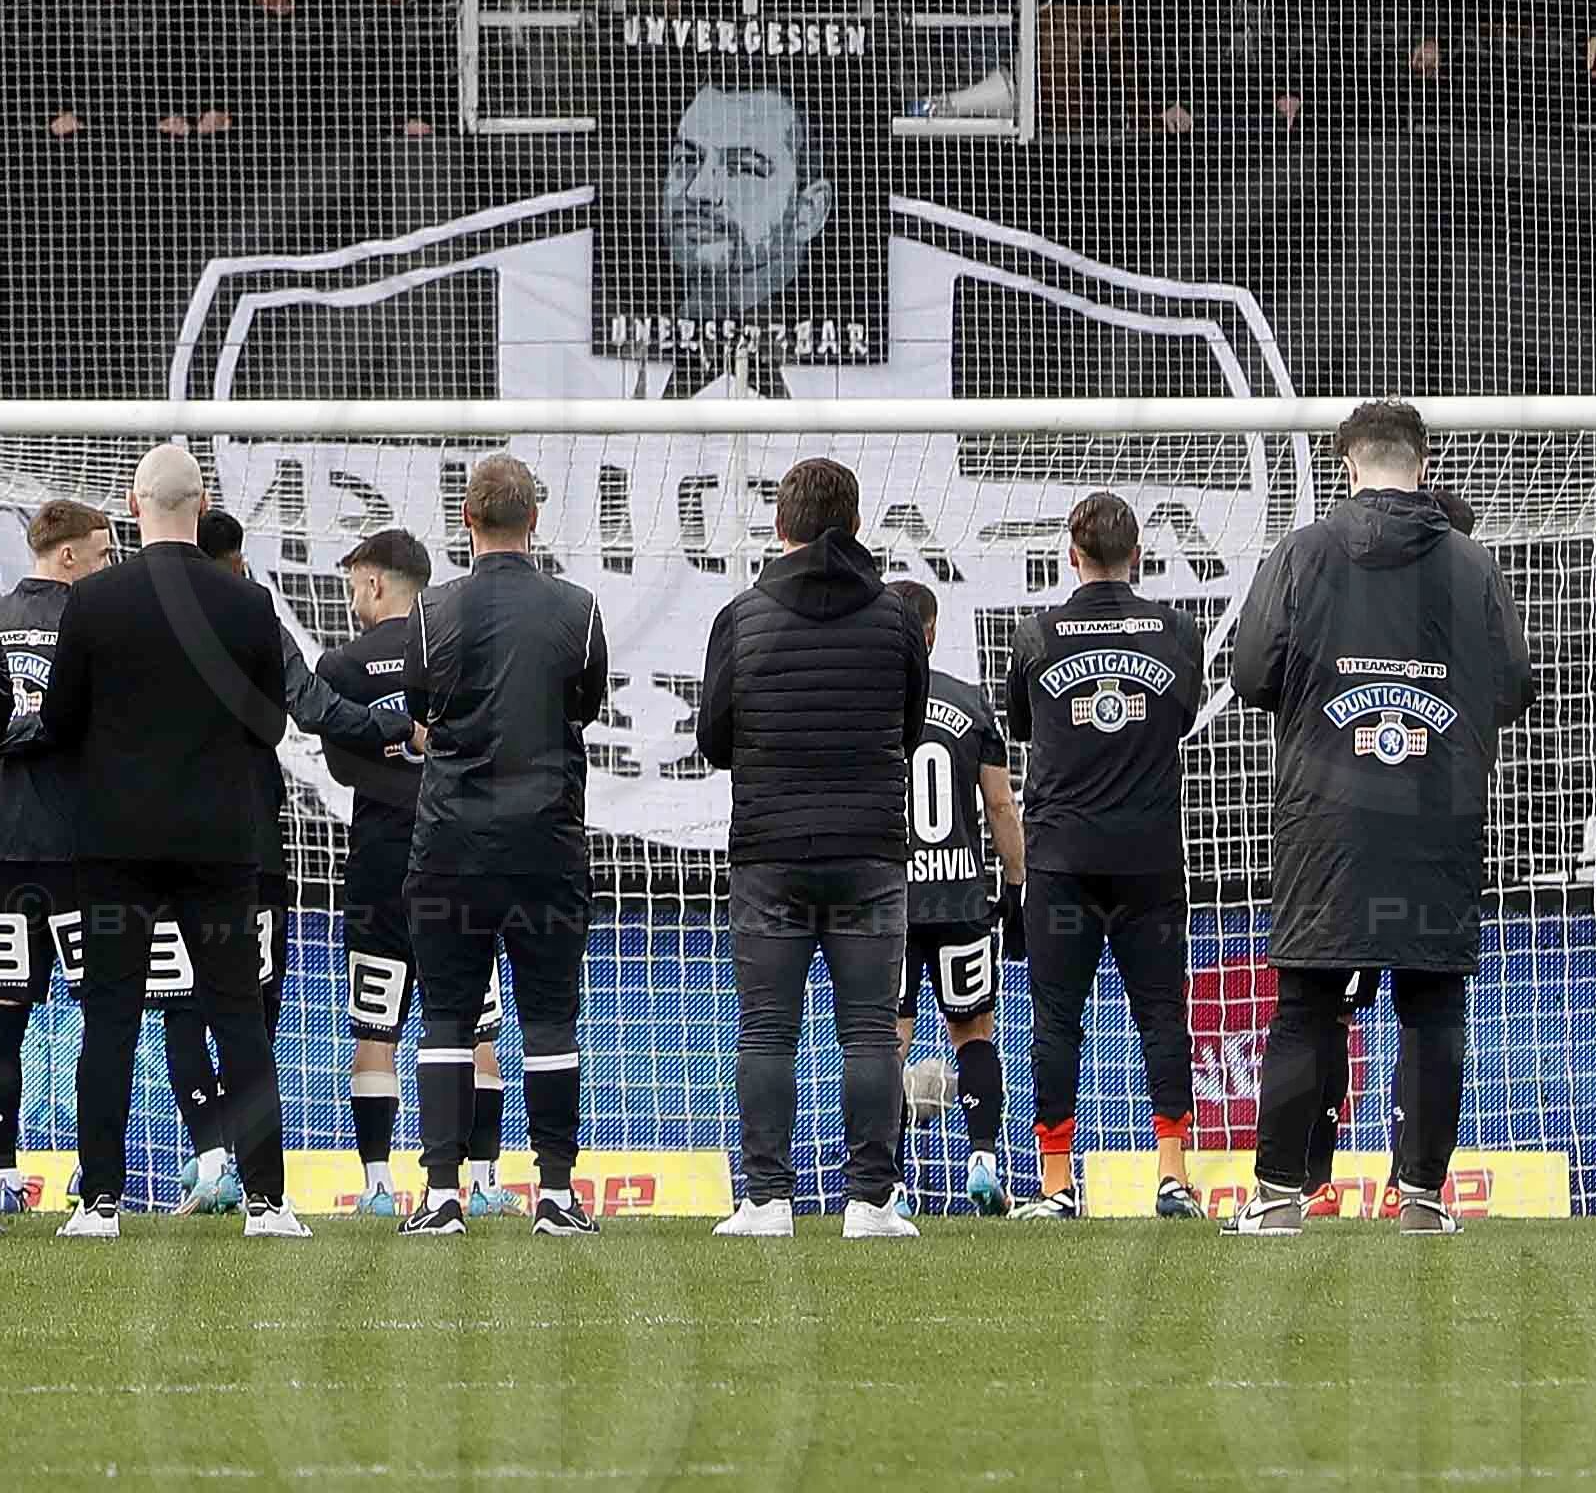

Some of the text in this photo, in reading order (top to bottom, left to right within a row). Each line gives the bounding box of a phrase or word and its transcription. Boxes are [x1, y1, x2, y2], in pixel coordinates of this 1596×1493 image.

[623, 15, 870, 56] UNVERGESSEN
[1049, 655, 1168, 697] PUNTIGAMER
[1330, 686, 1451, 728] PUNTIGAMER
